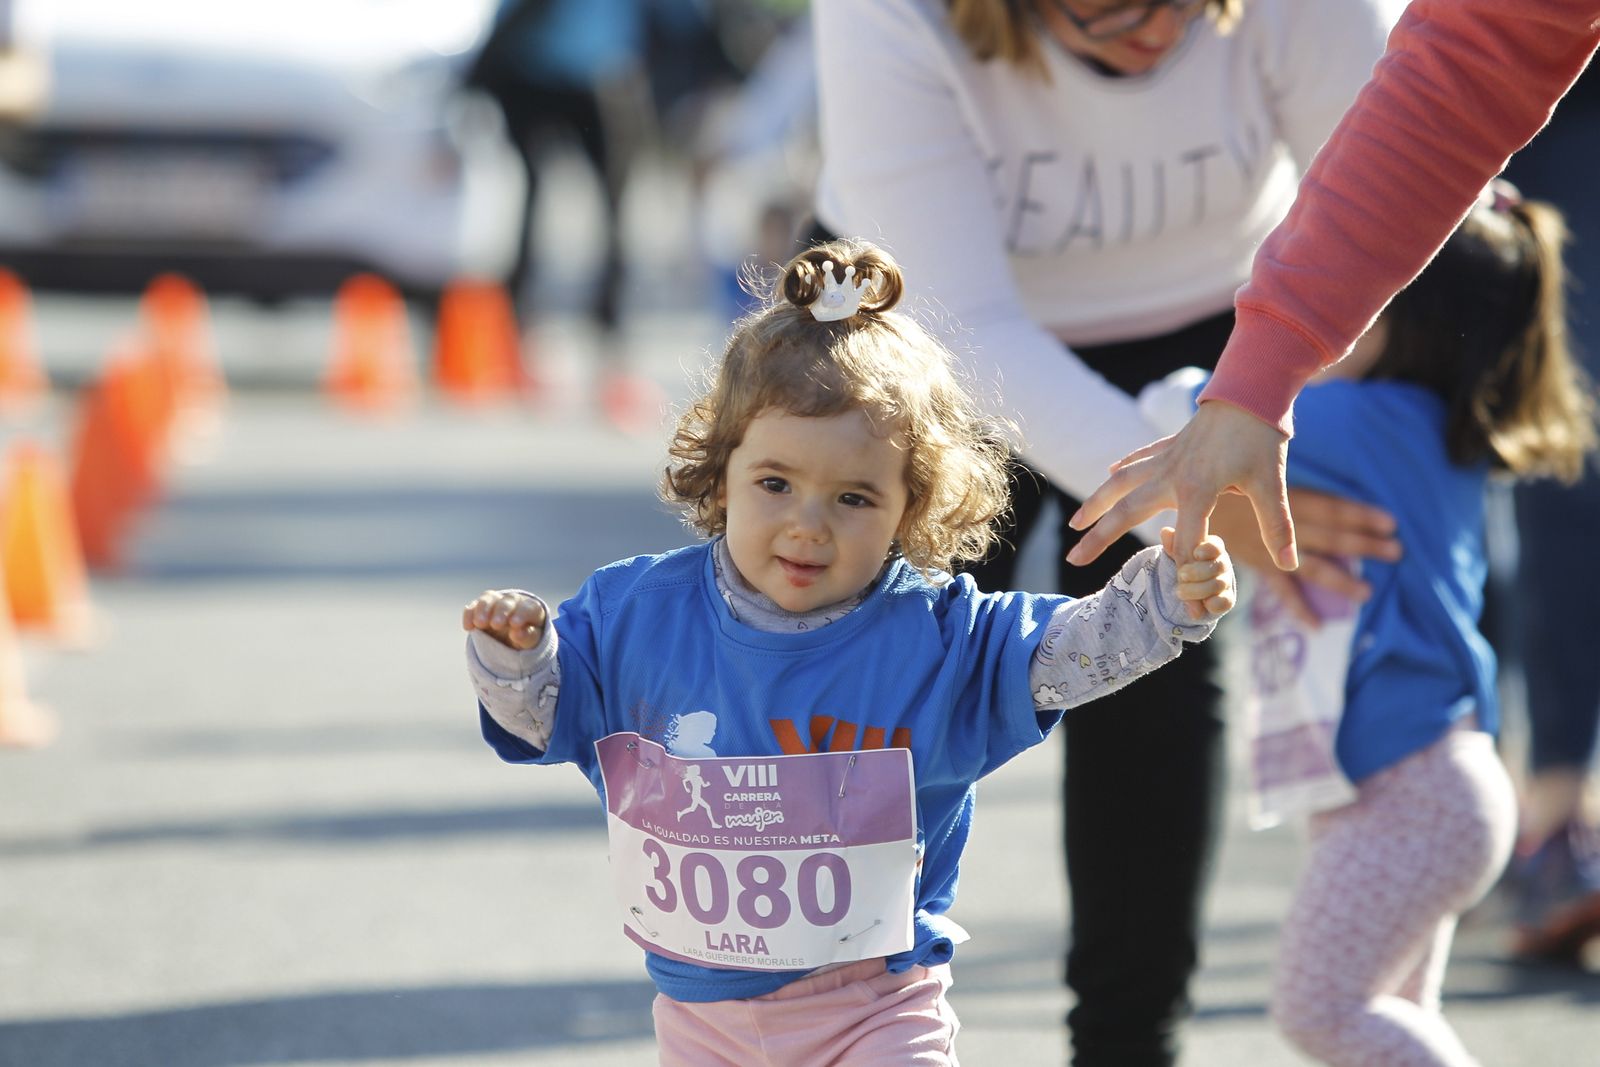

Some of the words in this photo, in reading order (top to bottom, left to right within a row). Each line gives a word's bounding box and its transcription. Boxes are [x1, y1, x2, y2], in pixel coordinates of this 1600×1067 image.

[721, 764, 779, 788] VIII
[723, 791, 782, 802] CARRERA
[642, 818, 653, 830] LA
[653, 824, 710, 845] IGUALDAD
[714, 835, 730, 846] ES
[734, 836, 798, 846] NUESTRA
[800, 834, 841, 845] META
[642, 838, 852, 930] 3080
[704, 930, 770, 956] LARA
[682, 946, 704, 960] LARA
[705, 951, 755, 966] GUERRERO
[757, 957, 806, 967] MORALES
